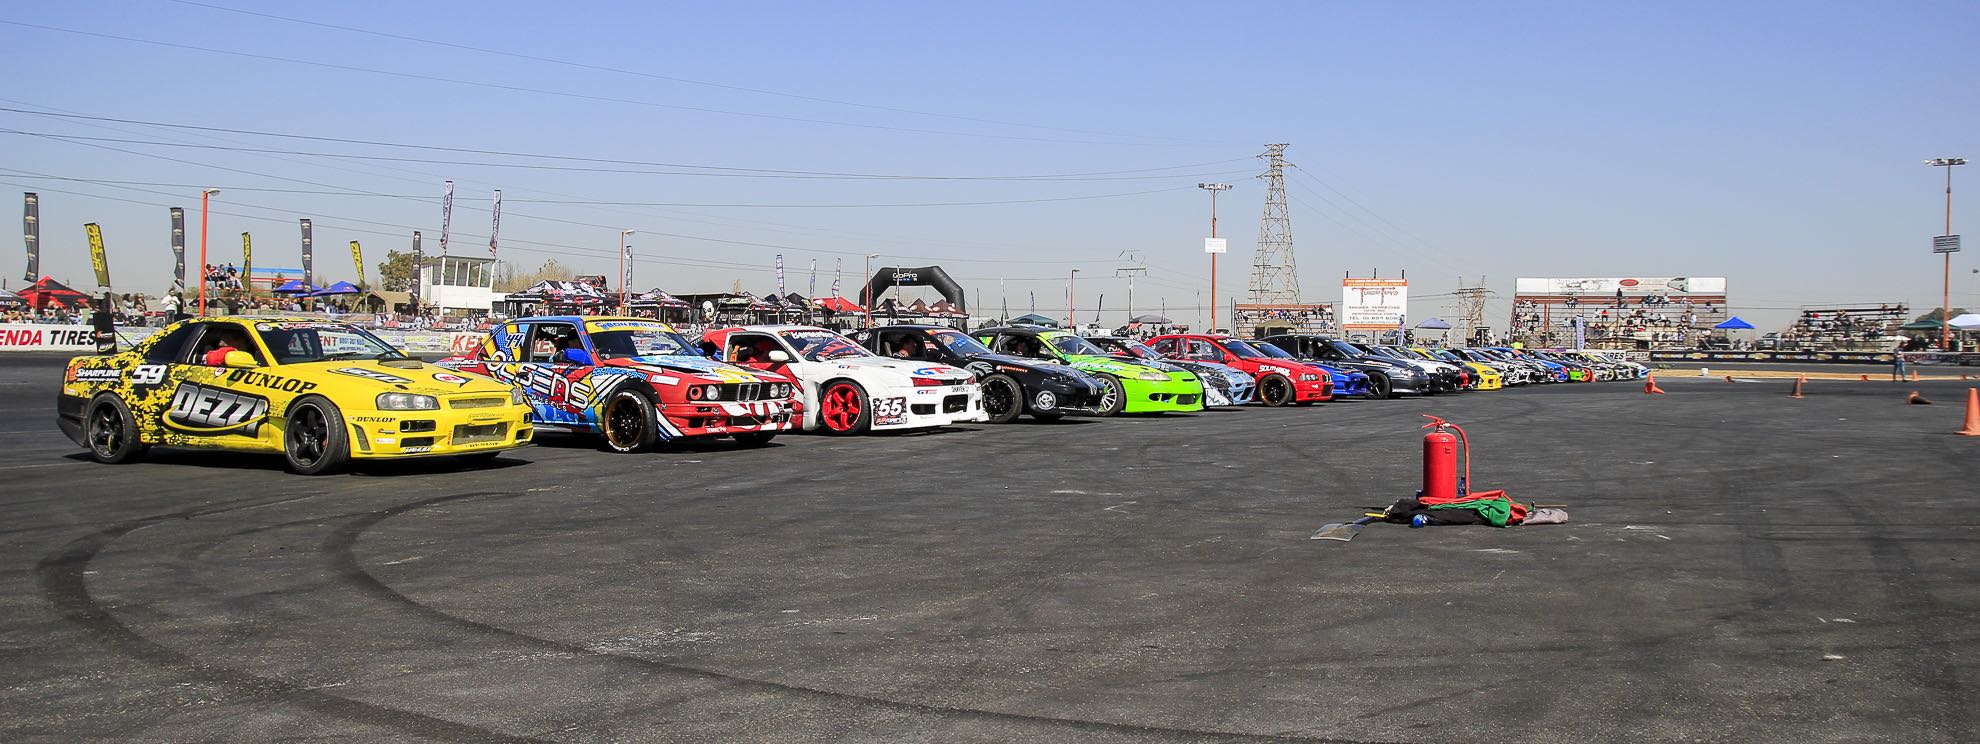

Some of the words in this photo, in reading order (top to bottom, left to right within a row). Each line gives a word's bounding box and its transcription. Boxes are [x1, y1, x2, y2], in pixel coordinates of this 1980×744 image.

[50, 329, 96, 346] TIRES
[505, 333, 525, 349] 44
[75, 368, 122, 378] SHARPLINE
[131, 363, 168, 385] 59
[226, 369, 318, 394] DUNLOP
[169, 383, 267, 434] DEZZI
[531, 393, 568, 411] WHEELS
[877, 398, 902, 416] 55
